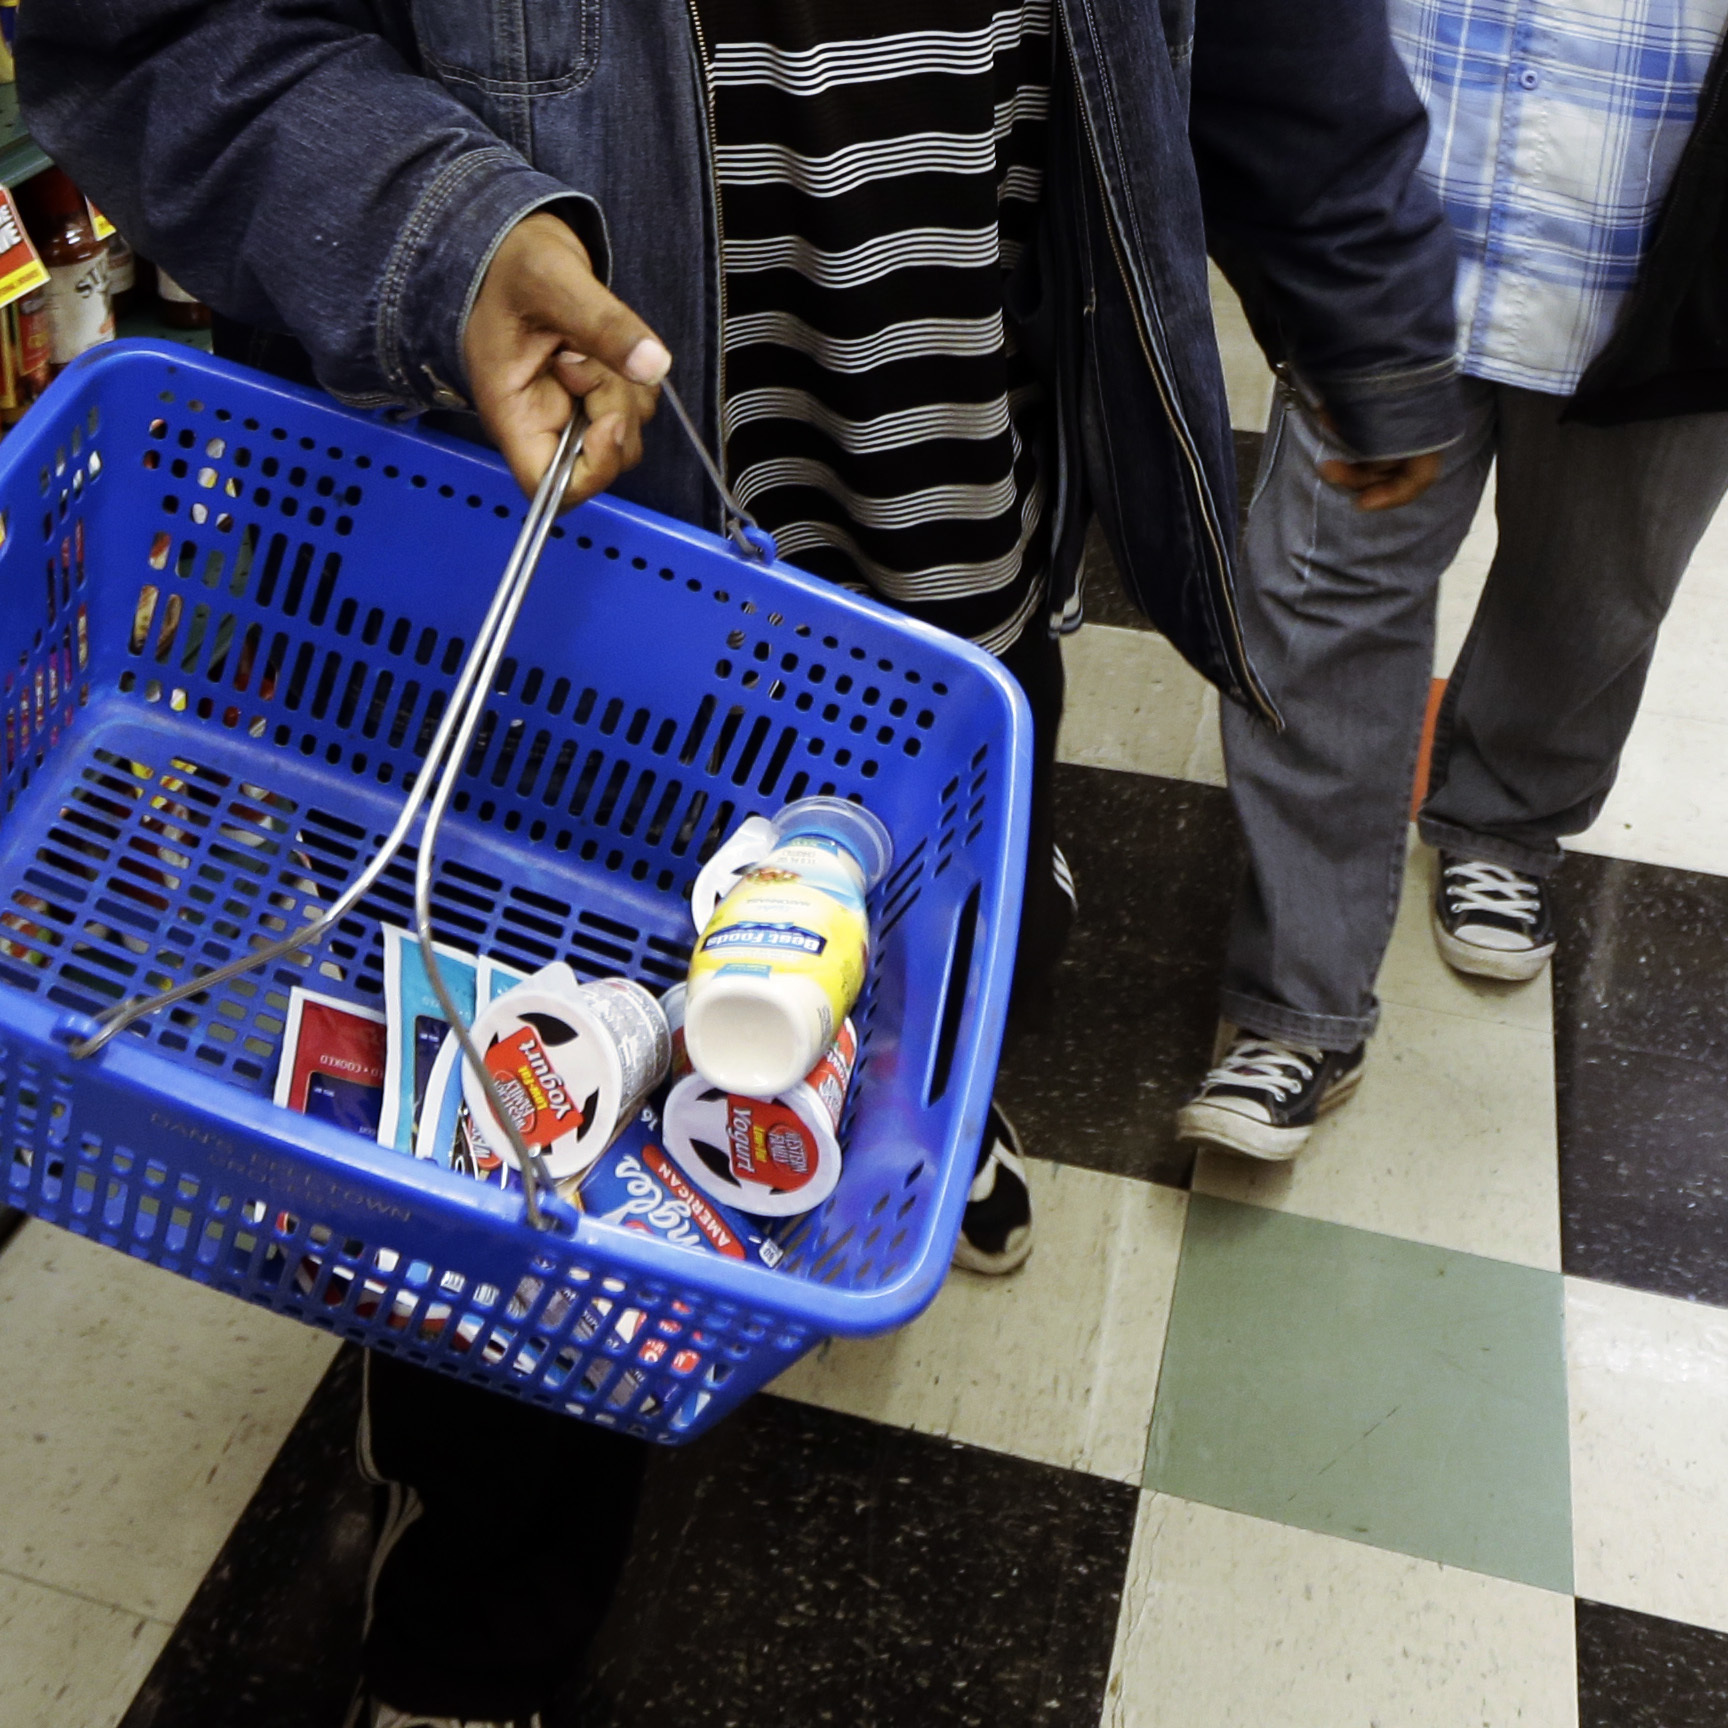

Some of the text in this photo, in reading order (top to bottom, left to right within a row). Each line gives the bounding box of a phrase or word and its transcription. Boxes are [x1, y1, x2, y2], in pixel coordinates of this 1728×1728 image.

[705, 929, 821, 953] Best Foods
[320, 1054, 362, 1074] COOKED
[518, 1038, 572, 1121] Yogurt
[505, 1078, 535, 1122] FAMILY
[517, 1064, 549, 1111] Low-Fat
[725, 1106, 755, 1173] Yogurt
[768, 1132, 790, 1165] FAMILY
[784, 1130, 809, 1173] WESTERN
[615, 1154, 706, 1252] ngles
[657, 1162, 731, 1248] AMERICAN
